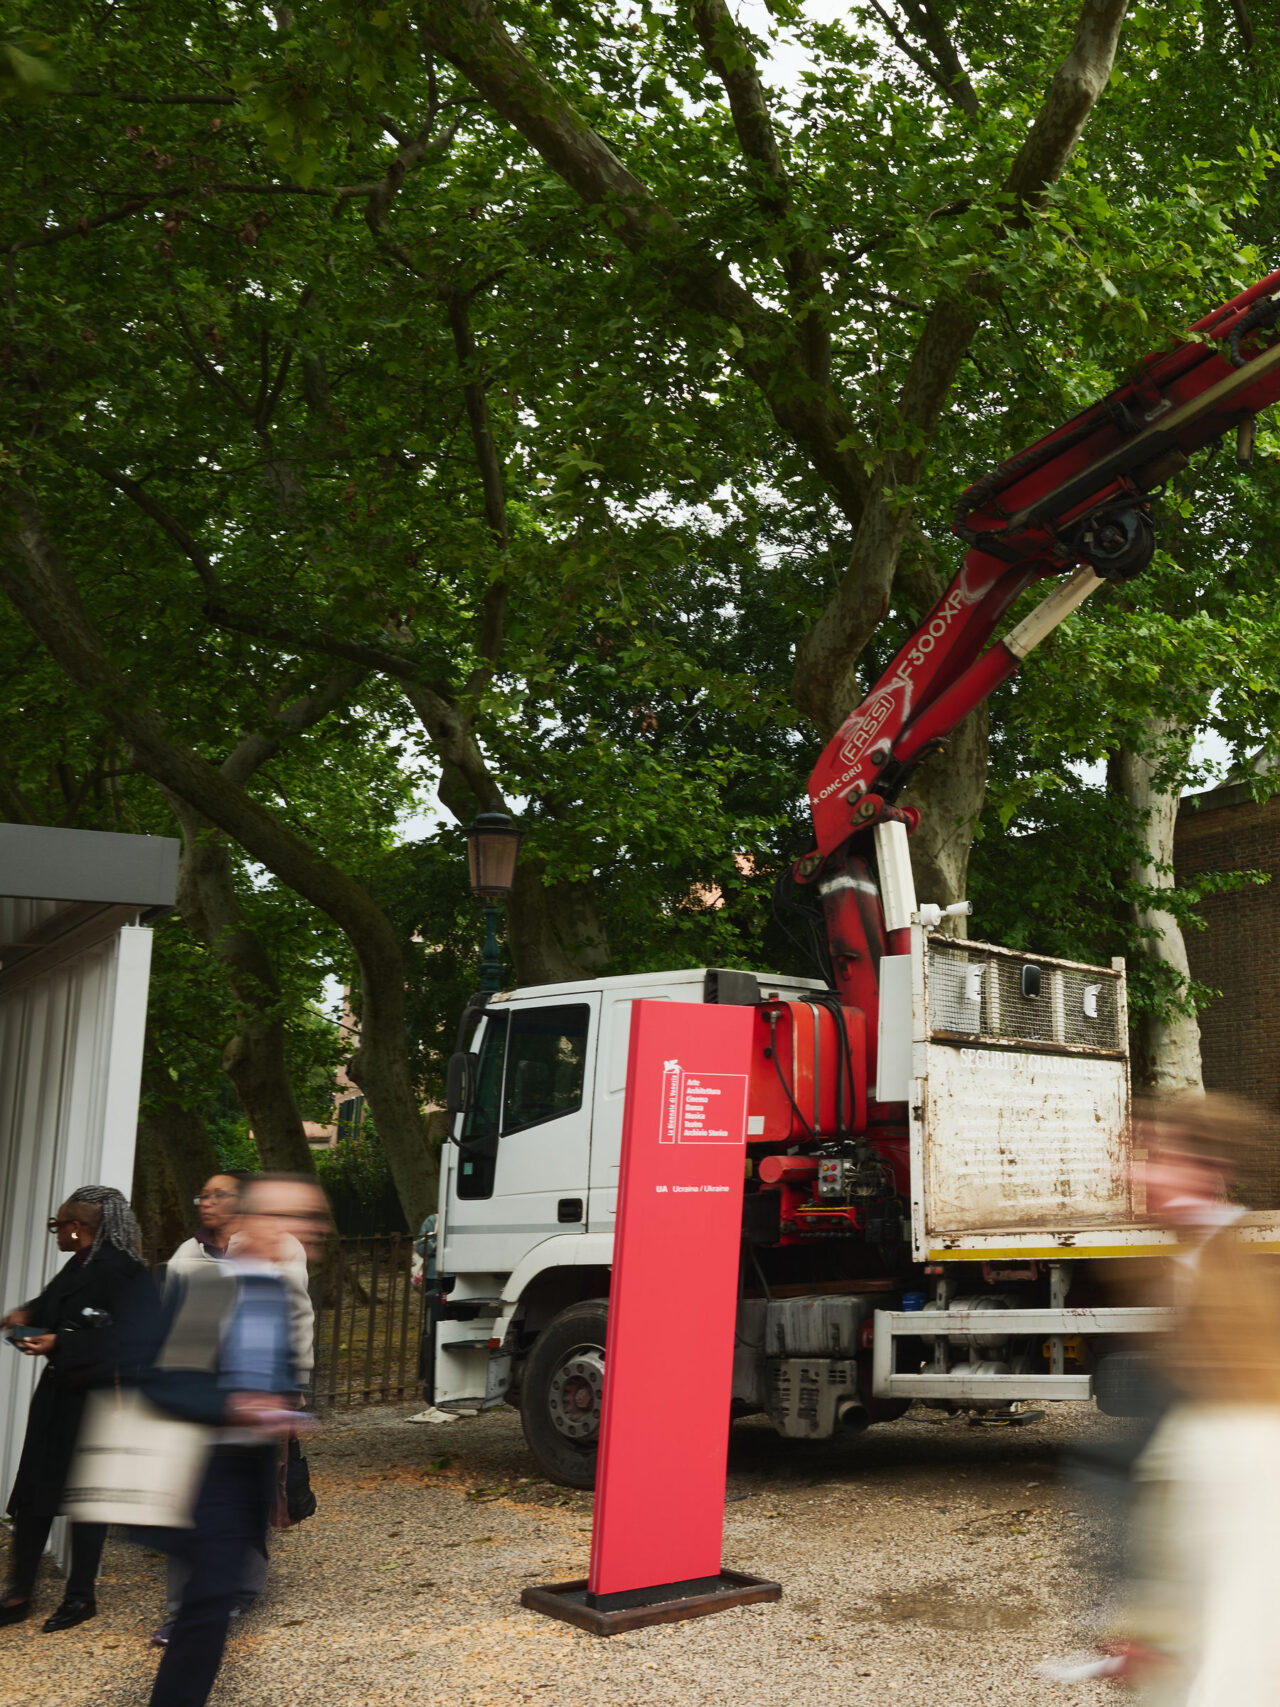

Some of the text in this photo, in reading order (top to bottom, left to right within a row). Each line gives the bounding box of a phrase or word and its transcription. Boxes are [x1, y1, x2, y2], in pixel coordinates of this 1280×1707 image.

[896, 589, 964, 683] F300XP
[843, 698, 891, 761] FASSI
[819, 763, 863, 799] OMC GRU
[959, 1048, 1026, 1070] SECURITY
